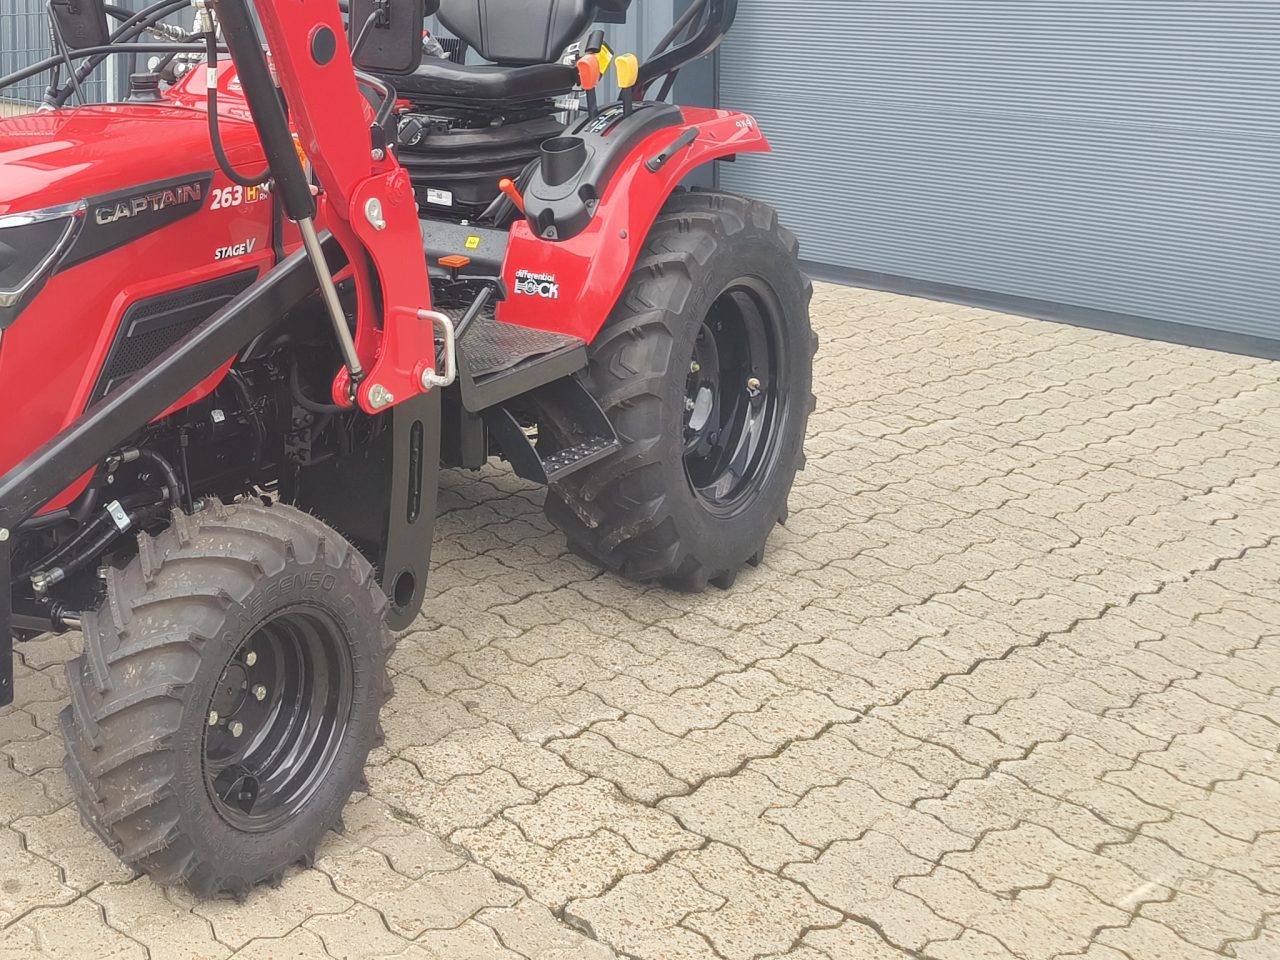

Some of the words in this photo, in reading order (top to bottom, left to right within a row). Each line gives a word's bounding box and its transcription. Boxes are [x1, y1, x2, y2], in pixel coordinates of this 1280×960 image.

[95, 182, 201, 225] CAPTAIN
[210, 185, 243, 211] 263
[515, 269, 555, 282] differential
